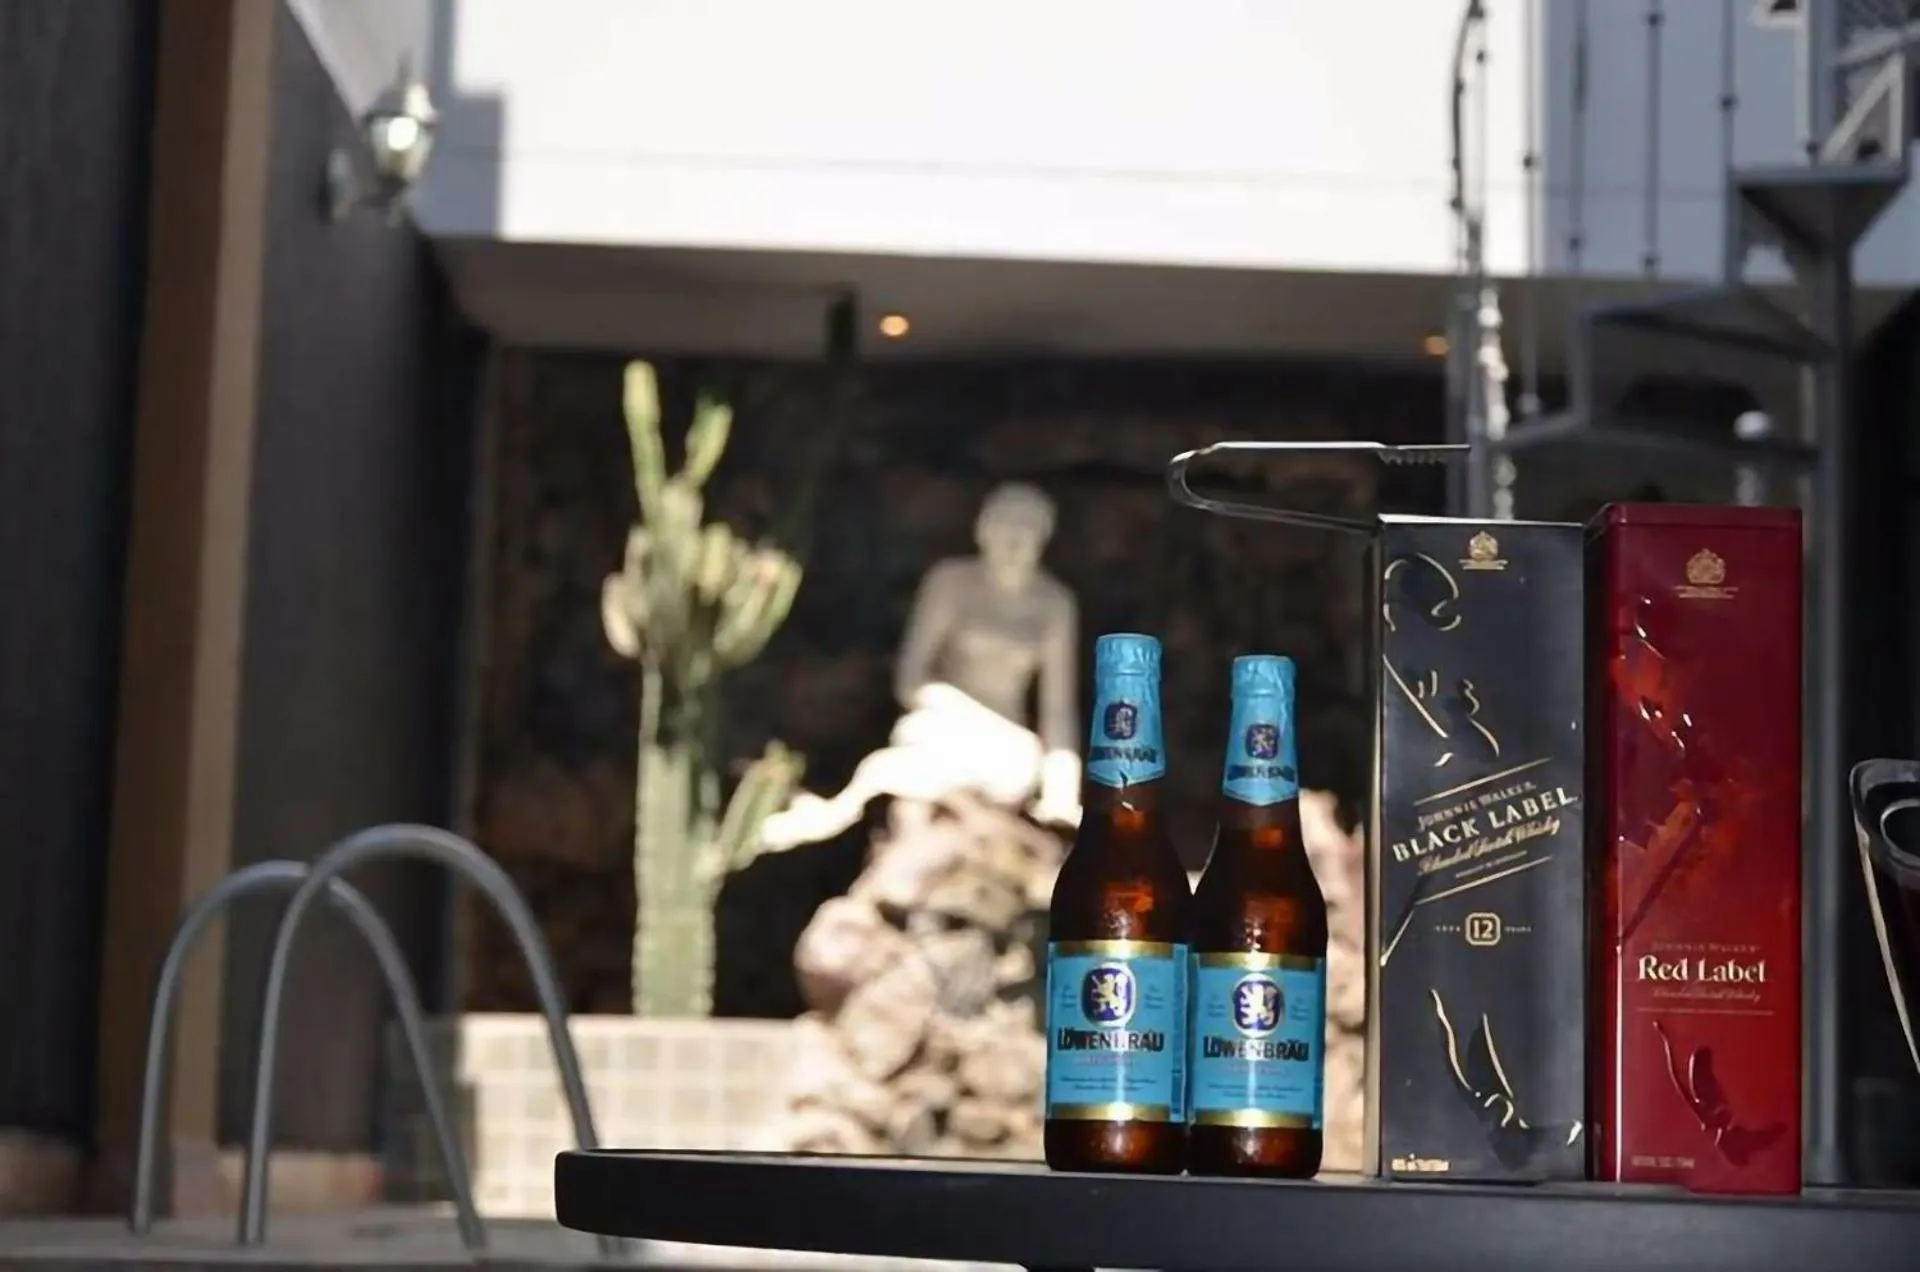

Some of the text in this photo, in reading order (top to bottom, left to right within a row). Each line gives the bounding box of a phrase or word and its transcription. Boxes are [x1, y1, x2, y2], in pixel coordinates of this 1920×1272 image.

[1392, 787, 1579, 862] BLACK LABEL
[1472, 919, 1495, 939] 12
[1638, 954, 1767, 984] Red Label
